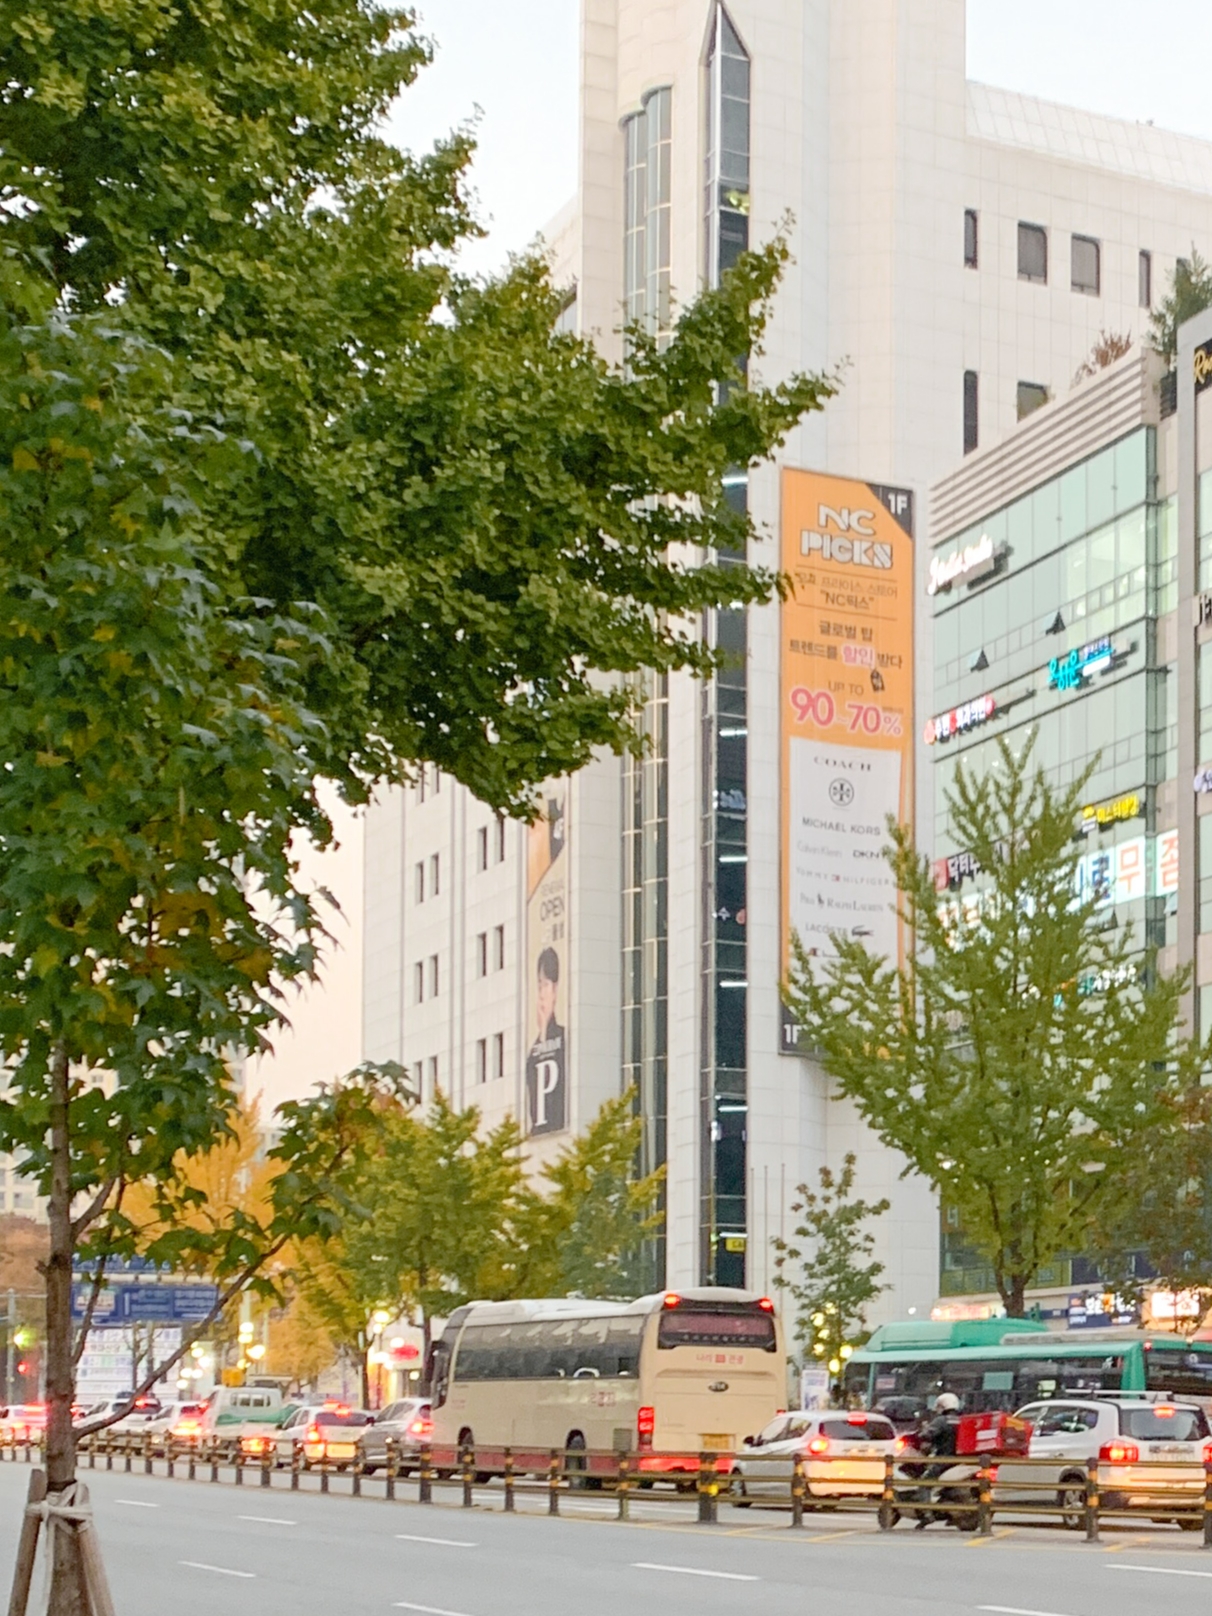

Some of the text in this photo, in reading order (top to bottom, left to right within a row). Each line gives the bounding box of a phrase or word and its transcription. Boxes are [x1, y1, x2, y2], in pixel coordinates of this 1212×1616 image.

[887, 493, 908, 515] 1F
[818, 503, 876, 536] NC
[800, 530, 893, 570] PICKS
[819, 620, 857, 640] 글로벌
[789, 639, 903, 669] 트렌드를 할인 받다
[828, 680, 865, 697] UP TO
[814, 755, 872, 772] COACH
[802, 816, 881, 837] MICHAEL KORS
[534, 1060, 560, 1126] P
